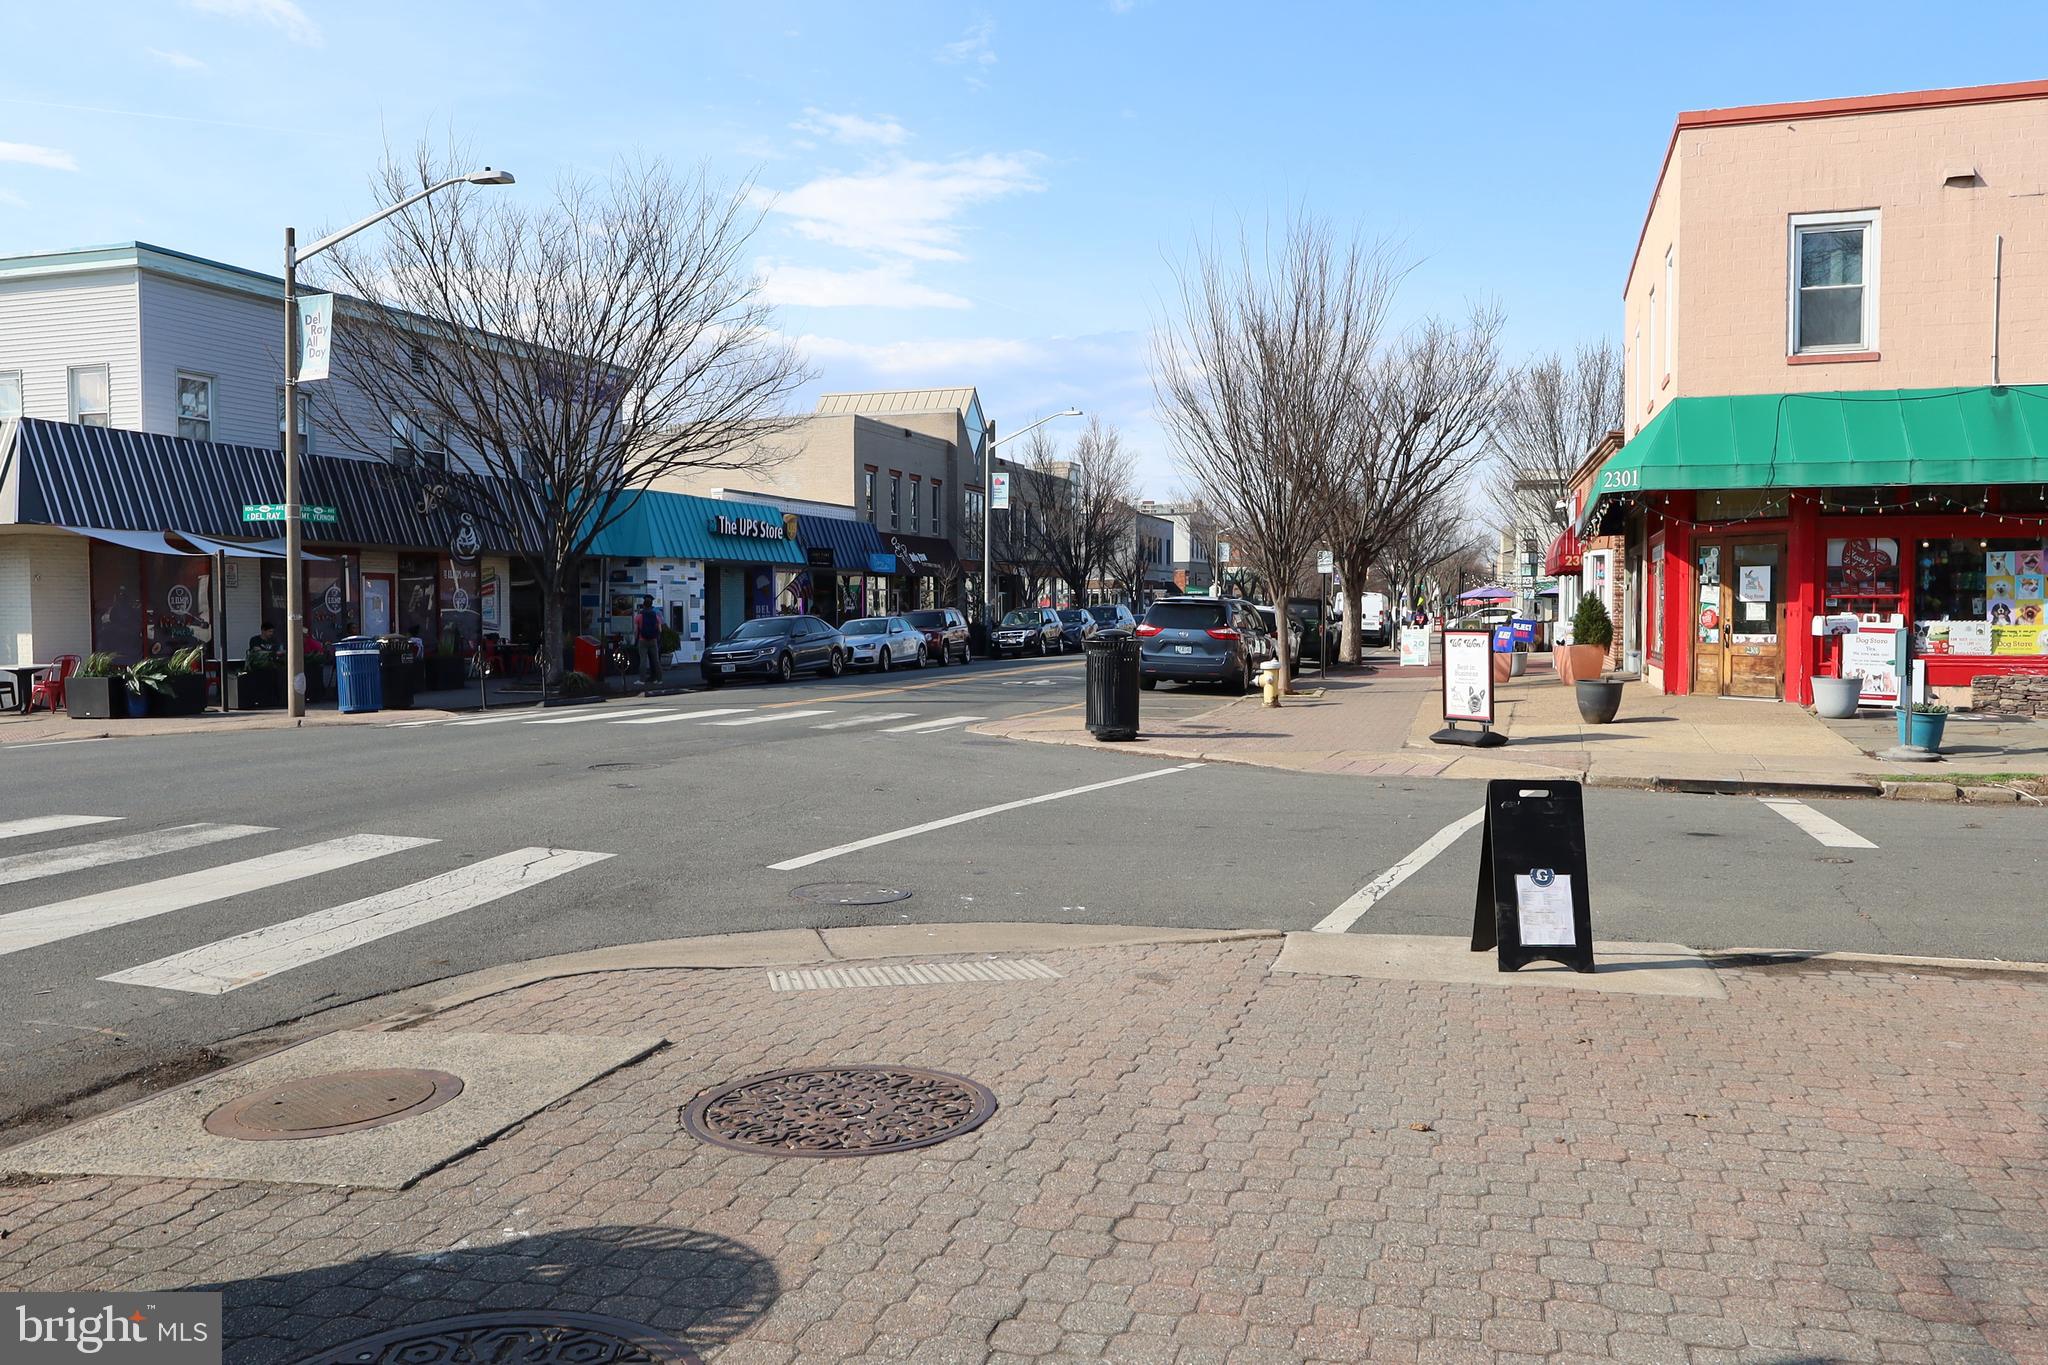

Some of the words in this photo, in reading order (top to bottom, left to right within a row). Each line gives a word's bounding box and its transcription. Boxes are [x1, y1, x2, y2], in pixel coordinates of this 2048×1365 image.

[305, 313, 321, 325] Del
[311, 324, 328, 336] Ray
[306, 336, 318, 348] All
[309, 348, 326, 359] Day
[1604, 470, 1638, 488] 2301
[250, 512, 264, 520] DEL
[266, 512, 280, 520] RAY
[312, 513, 335, 521] VERNON
[719, 515, 737, 535] The
[739, 518, 758, 537] UPS
[760, 520, 783, 539] Store
[1565, 555, 1583, 566] 23
[755, 604, 770, 614] DEL
[1513, 623, 1533, 631] REJECT
[1449, 638, 1462, 648] We
[1463, 638, 1485, 648] Won!
[1855, 637, 1869, 645] Dog
[1997, 640, 2012, 648] Dog
